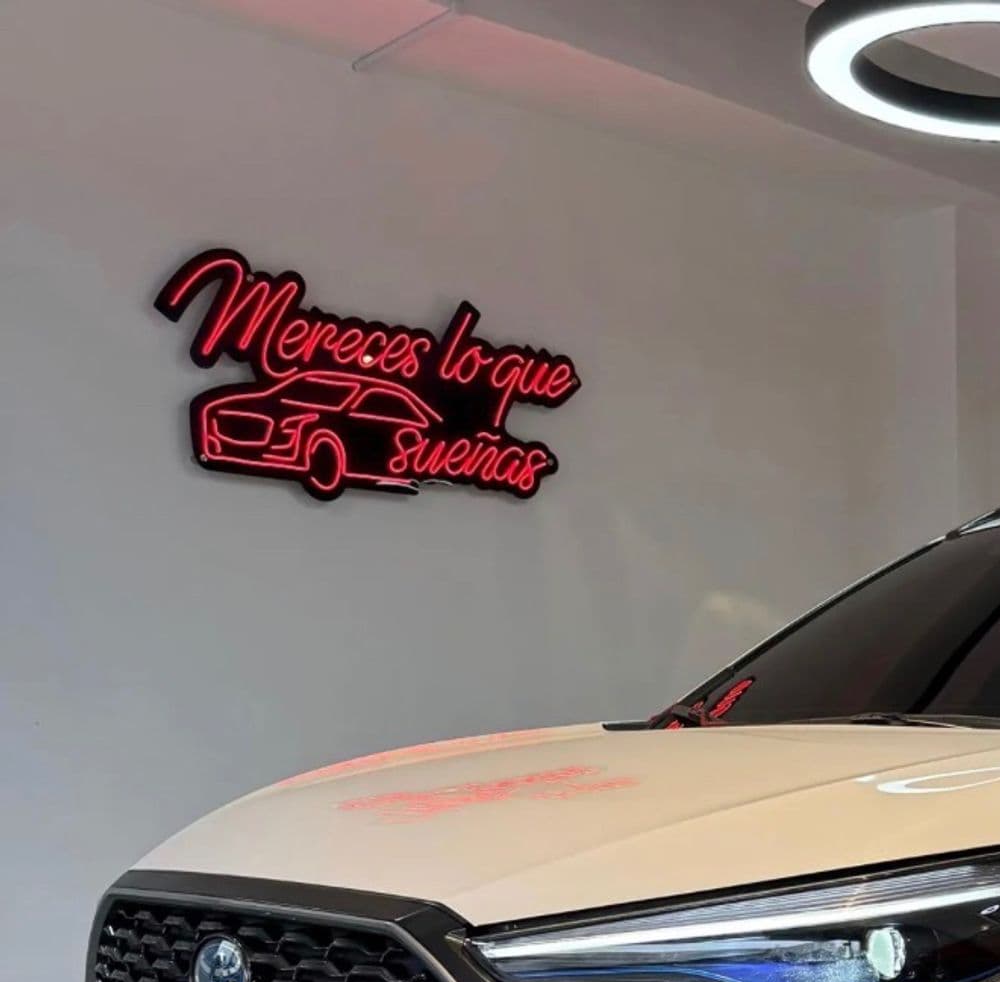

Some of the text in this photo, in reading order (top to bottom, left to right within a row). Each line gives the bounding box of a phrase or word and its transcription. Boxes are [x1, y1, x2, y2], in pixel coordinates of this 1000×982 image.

[170, 257, 577, 428] Mereces lo que
